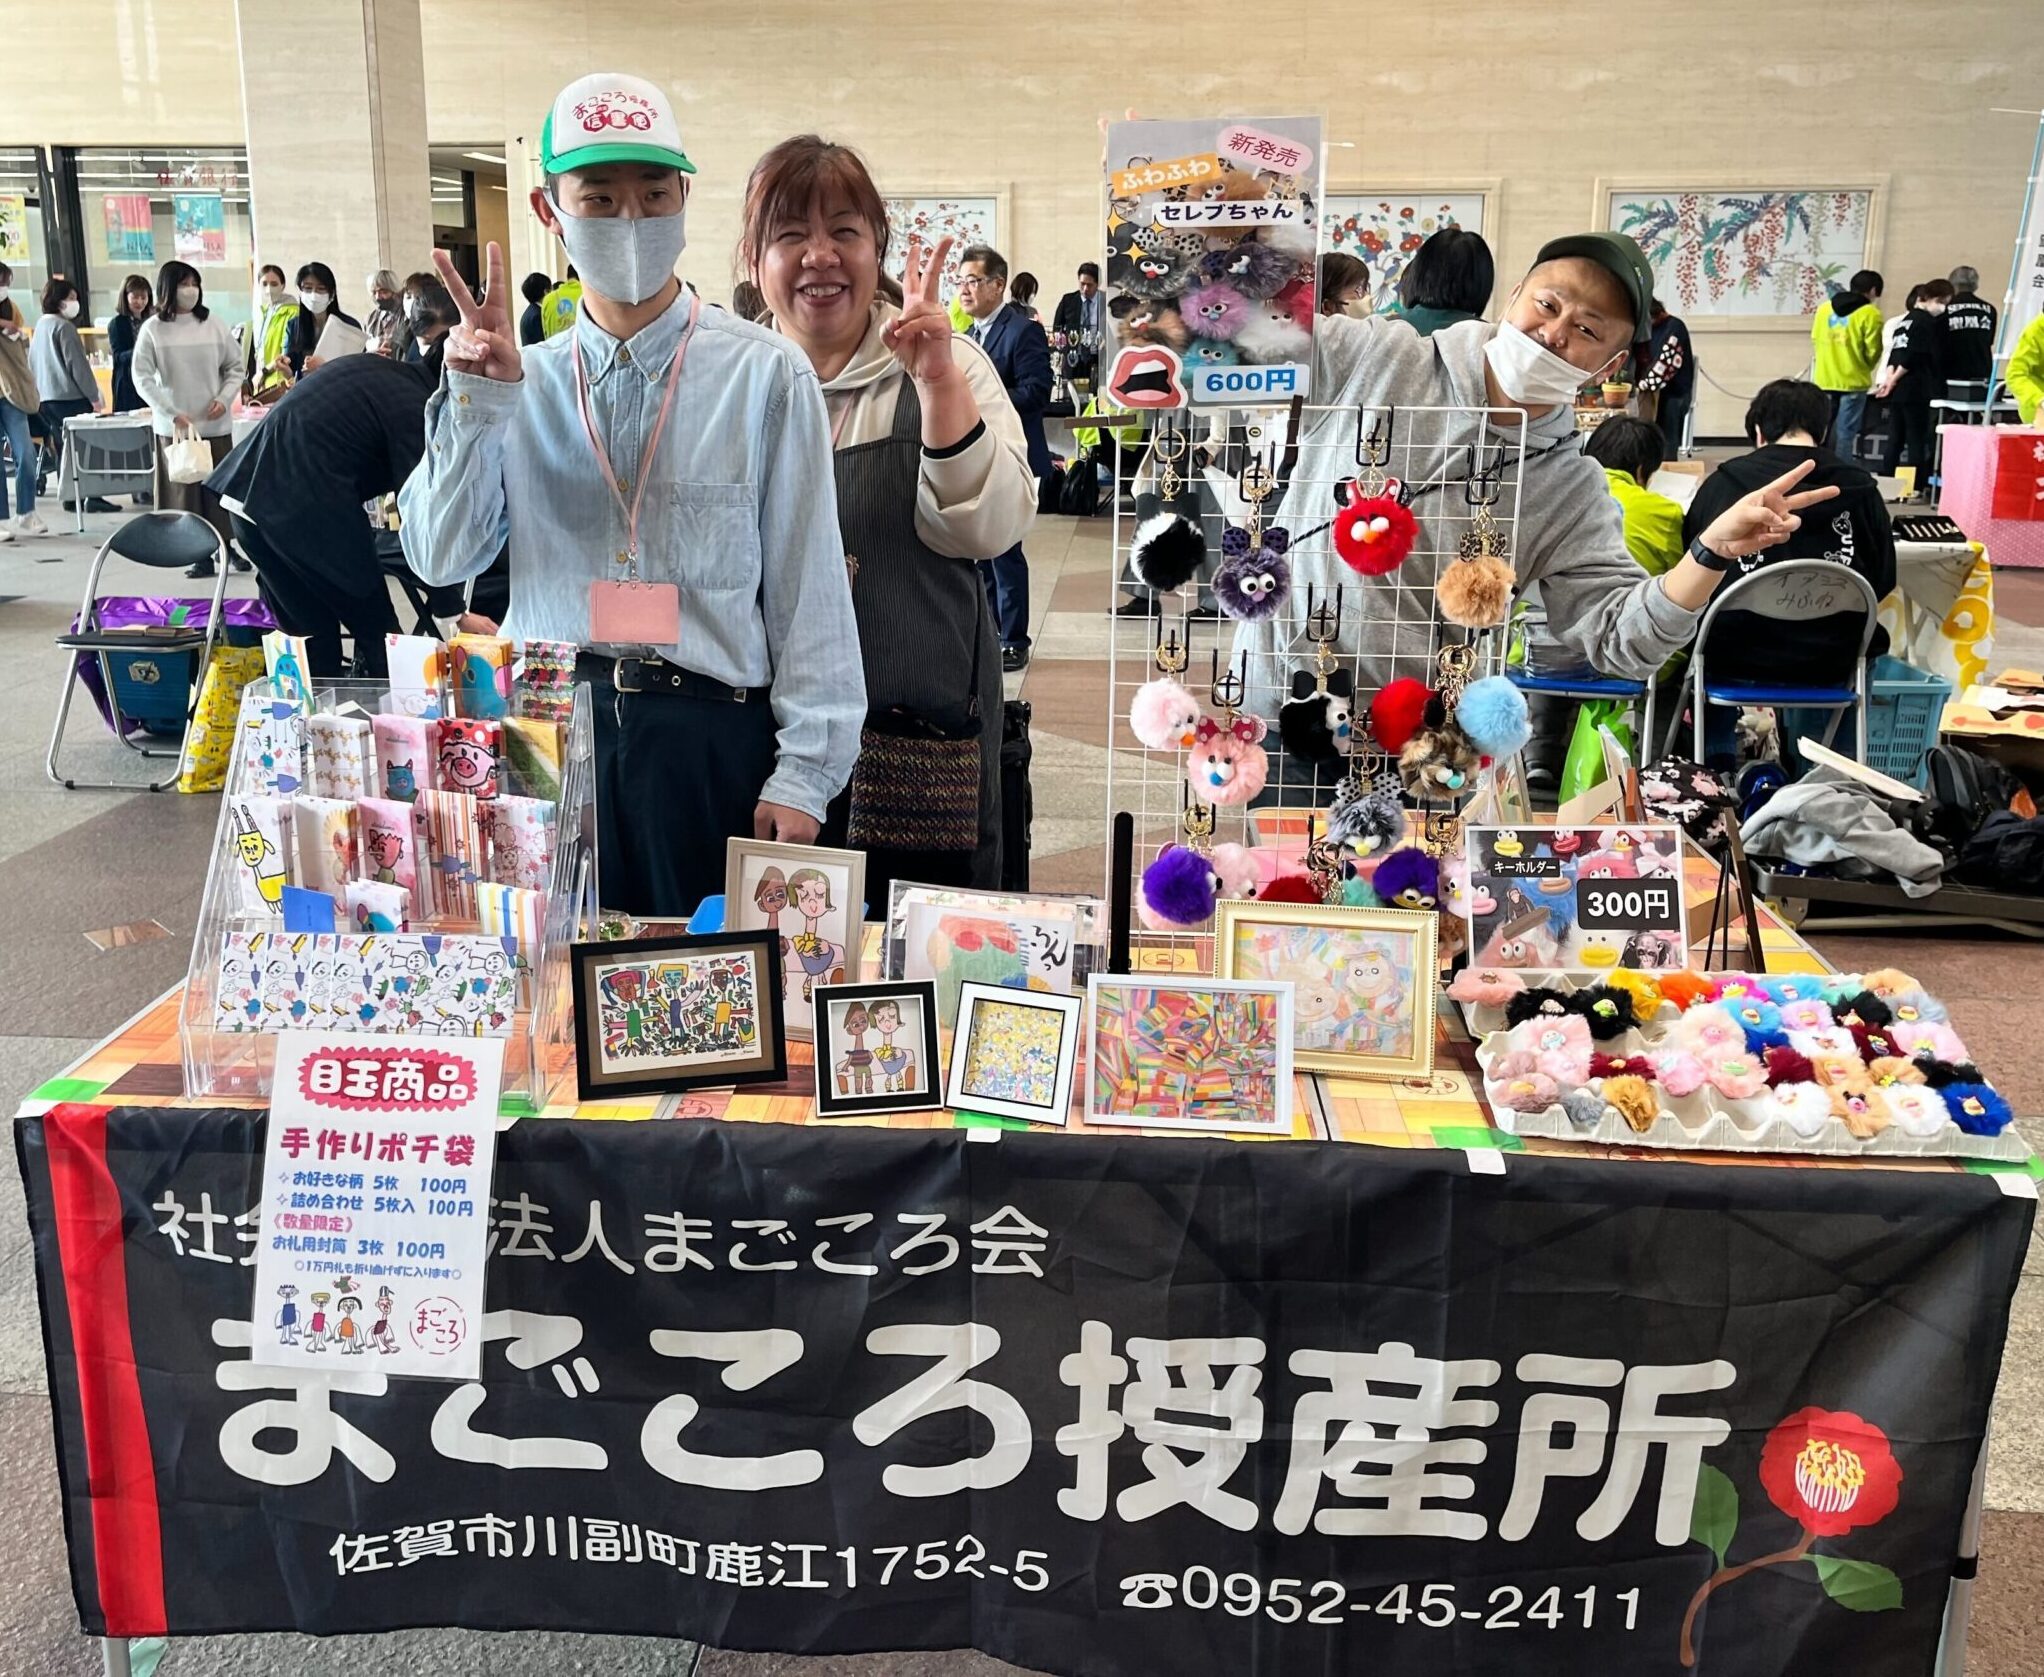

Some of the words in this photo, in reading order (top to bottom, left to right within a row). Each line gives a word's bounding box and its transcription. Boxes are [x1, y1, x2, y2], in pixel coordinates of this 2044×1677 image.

[1227, 132, 1301, 168] 新発売
[1122, 158, 1211, 190] ふわふわ
[1160, 203, 1294, 221] セレブちゃん
[1206, 369, 1296, 392] 600円
[1494, 860, 1557, 875] キーホルダー
[1587, 889, 1670, 919] 300円
[309, 1057, 469, 1102] 目玉商品
[280, 1127, 476, 1167] 手作りポチ袋
[292, 1171, 364, 1190] お好きな柄
[373, 1175, 399, 1191] 5枚
[420, 1177, 466, 1194] 100円
[290, 1192, 364, 1211] 詰め合わせ
[374, 1197, 415, 1214] 5枚入
[428, 1199, 473, 1217] 100円
[272, 1235, 347, 1254] お札用封筒
[357, 1240, 384, 1256] 3枚
[397, 1241, 445, 1259] 100円
[211, 1308, 1738, 1547] まごころ授産所
[329, 1511, 1049, 1595] 佐賀市川副町鹿江1752-5
[1181, 1564, 1642, 1632] 0952-45-2411
